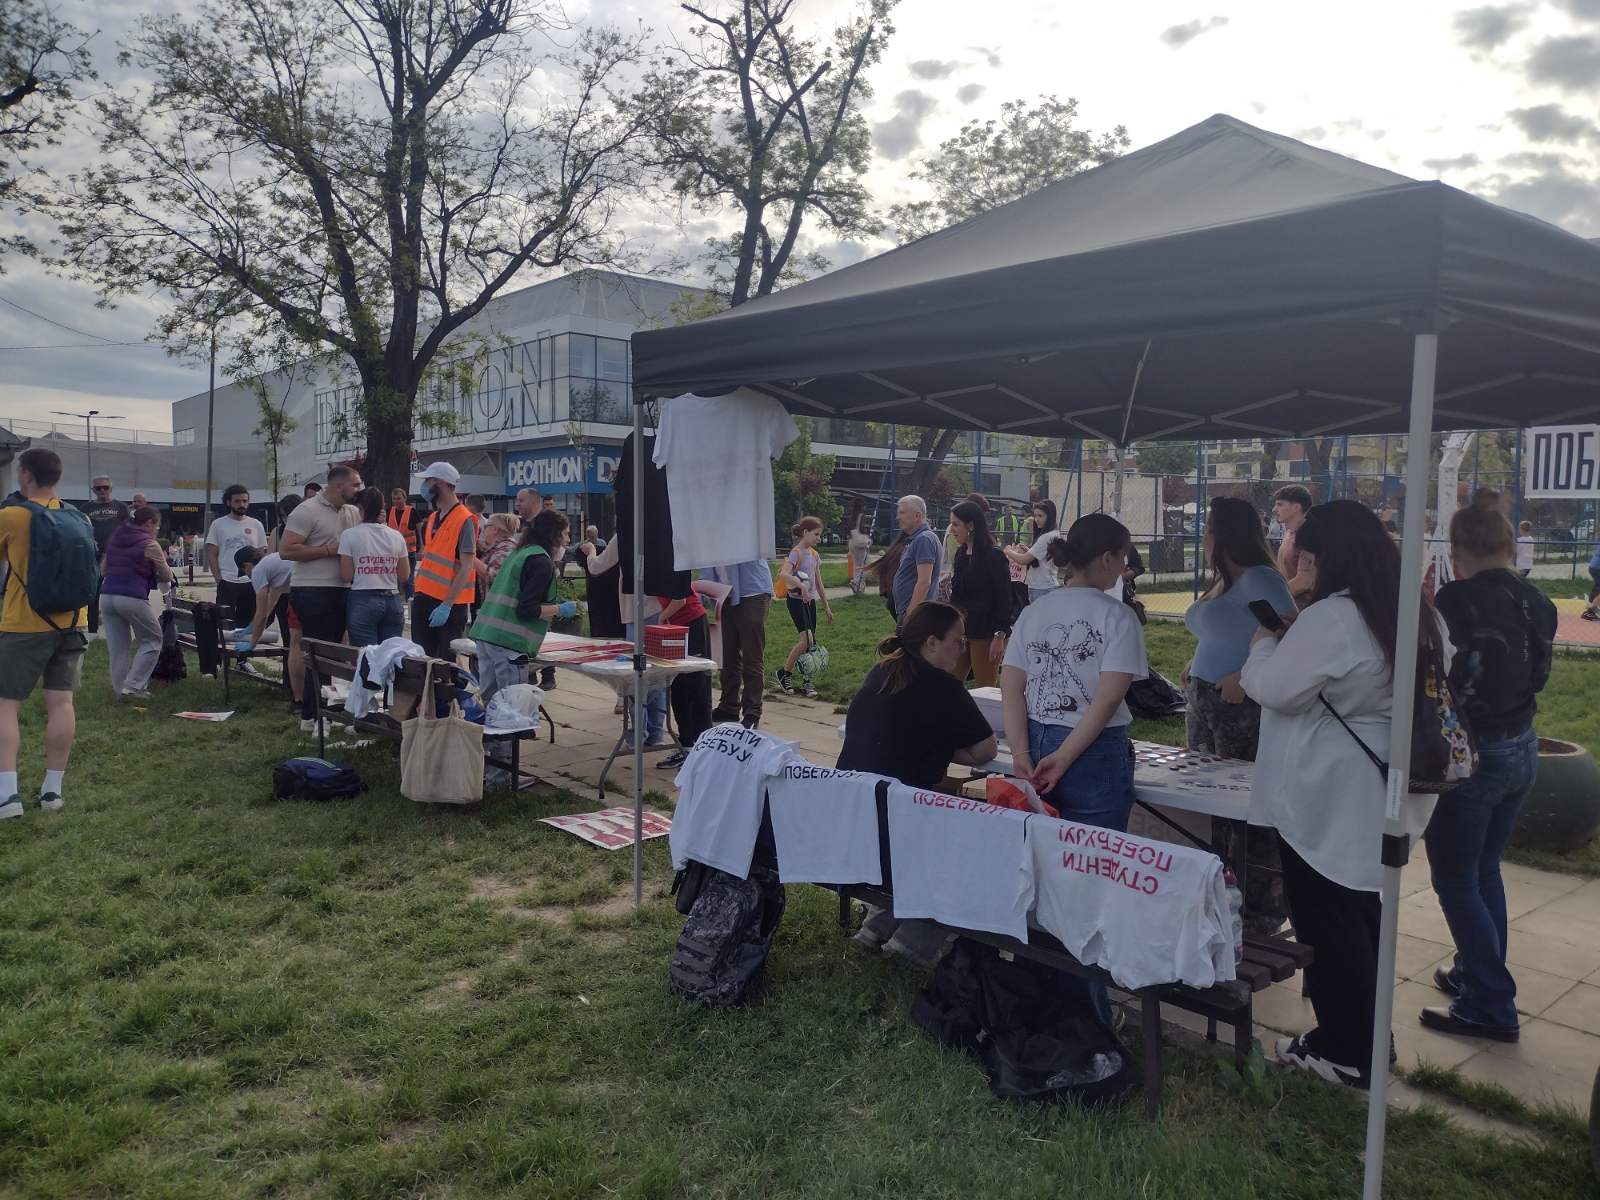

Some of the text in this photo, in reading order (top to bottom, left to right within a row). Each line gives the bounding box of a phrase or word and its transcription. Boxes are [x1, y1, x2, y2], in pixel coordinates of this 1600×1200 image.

[508, 456, 582, 486] DECATHLON
[1532, 431, 1600, 490] ПОБ
[1059, 824, 1173, 873] ПОБЕЂУЈУ!
[1062, 851, 1159, 895] СТУДЕНТИ
